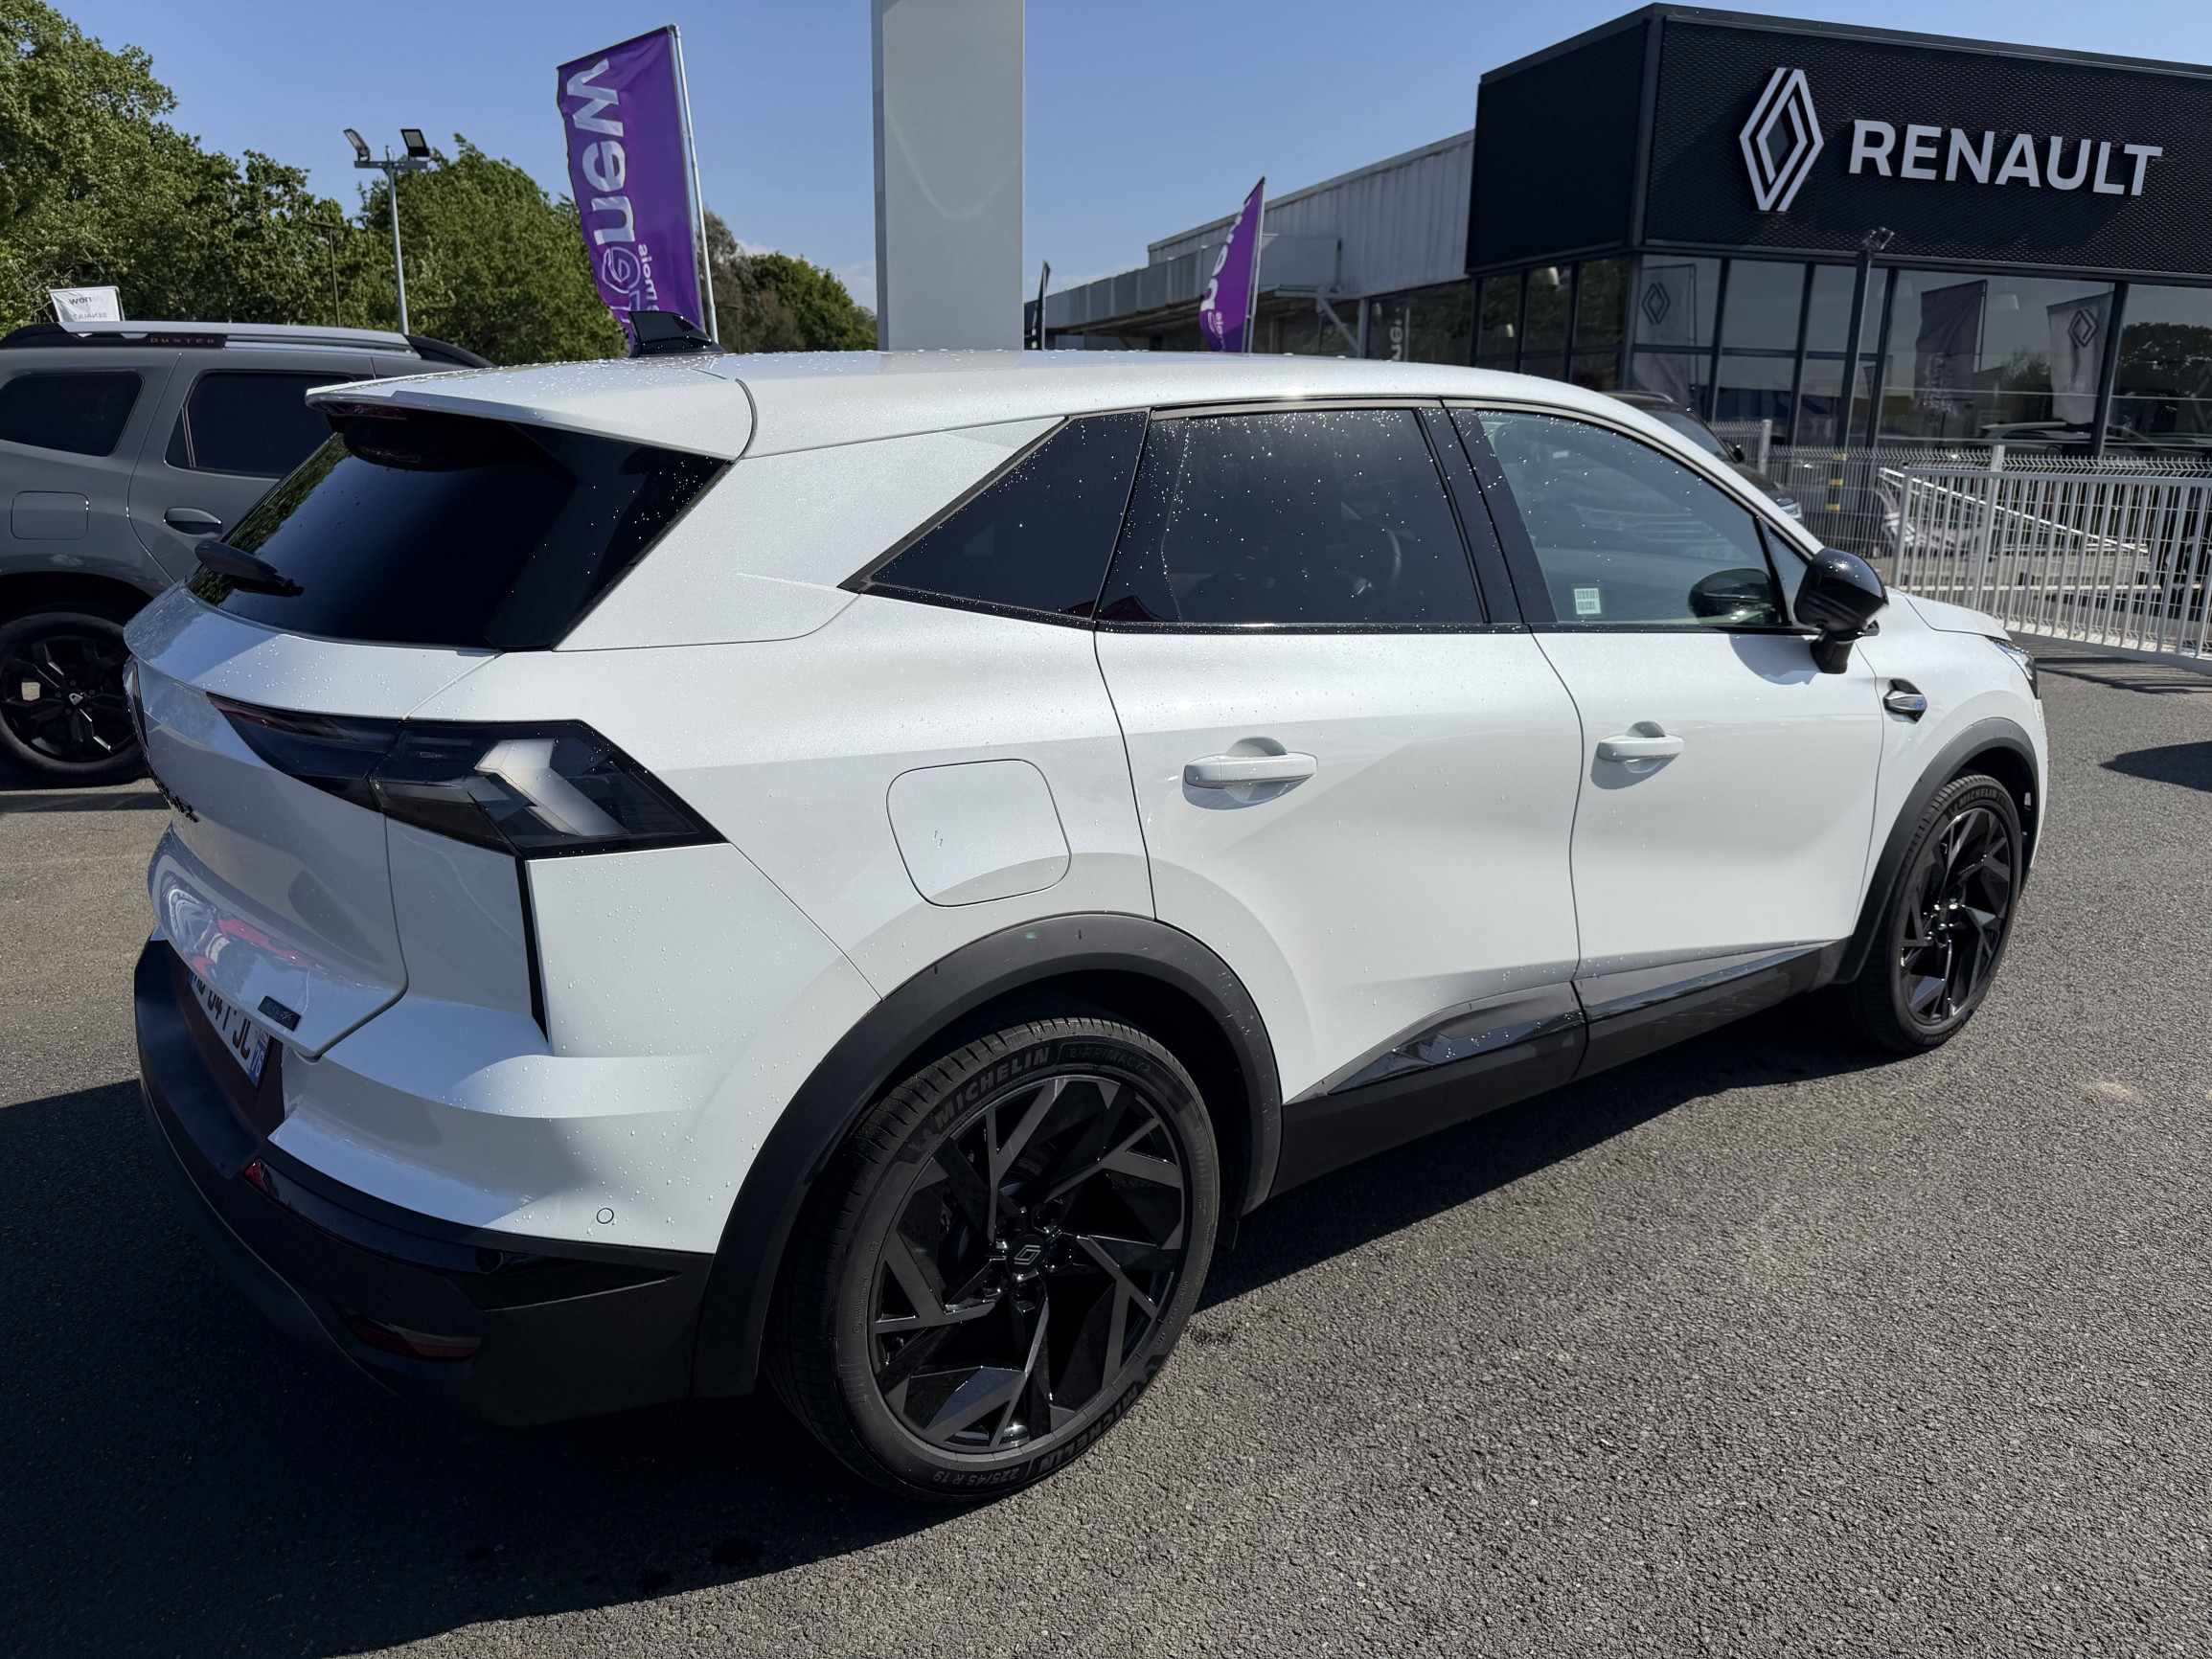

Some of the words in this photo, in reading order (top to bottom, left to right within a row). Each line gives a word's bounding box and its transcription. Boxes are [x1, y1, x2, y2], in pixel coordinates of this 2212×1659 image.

[1848, 118, 2164, 196] RENAULT
[1959, 787, 1998, 808] MICHELIN
[935, 1047, 1050, 1129] MICHELIN
[1038, 1385, 1138, 1473] MICHELIN
[932, 1470, 950, 1484] 19
[952, 1473, 964, 1486] R
[966, 1466, 1020, 1486] 225/45
